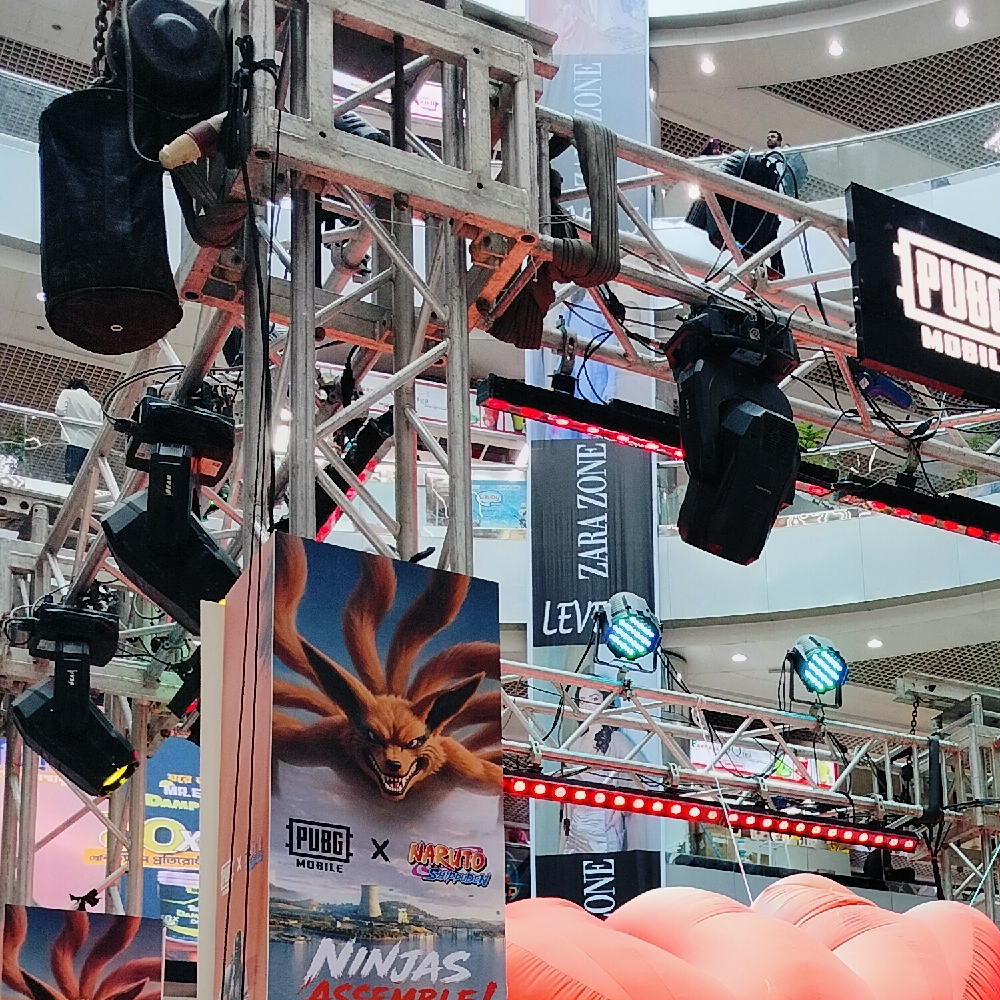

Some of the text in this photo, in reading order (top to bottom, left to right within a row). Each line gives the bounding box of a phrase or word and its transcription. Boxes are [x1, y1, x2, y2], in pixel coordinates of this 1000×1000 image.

[576, 442, 609, 580] ZARA ZONE
[296, 825, 344, 856] PUBG
[408, 840, 488, 872] NARUTO
[296, 858, 344, 874] MOBILE
[582, 858, 616, 917] ONE
[303, 936, 472, 985] NINJAS
